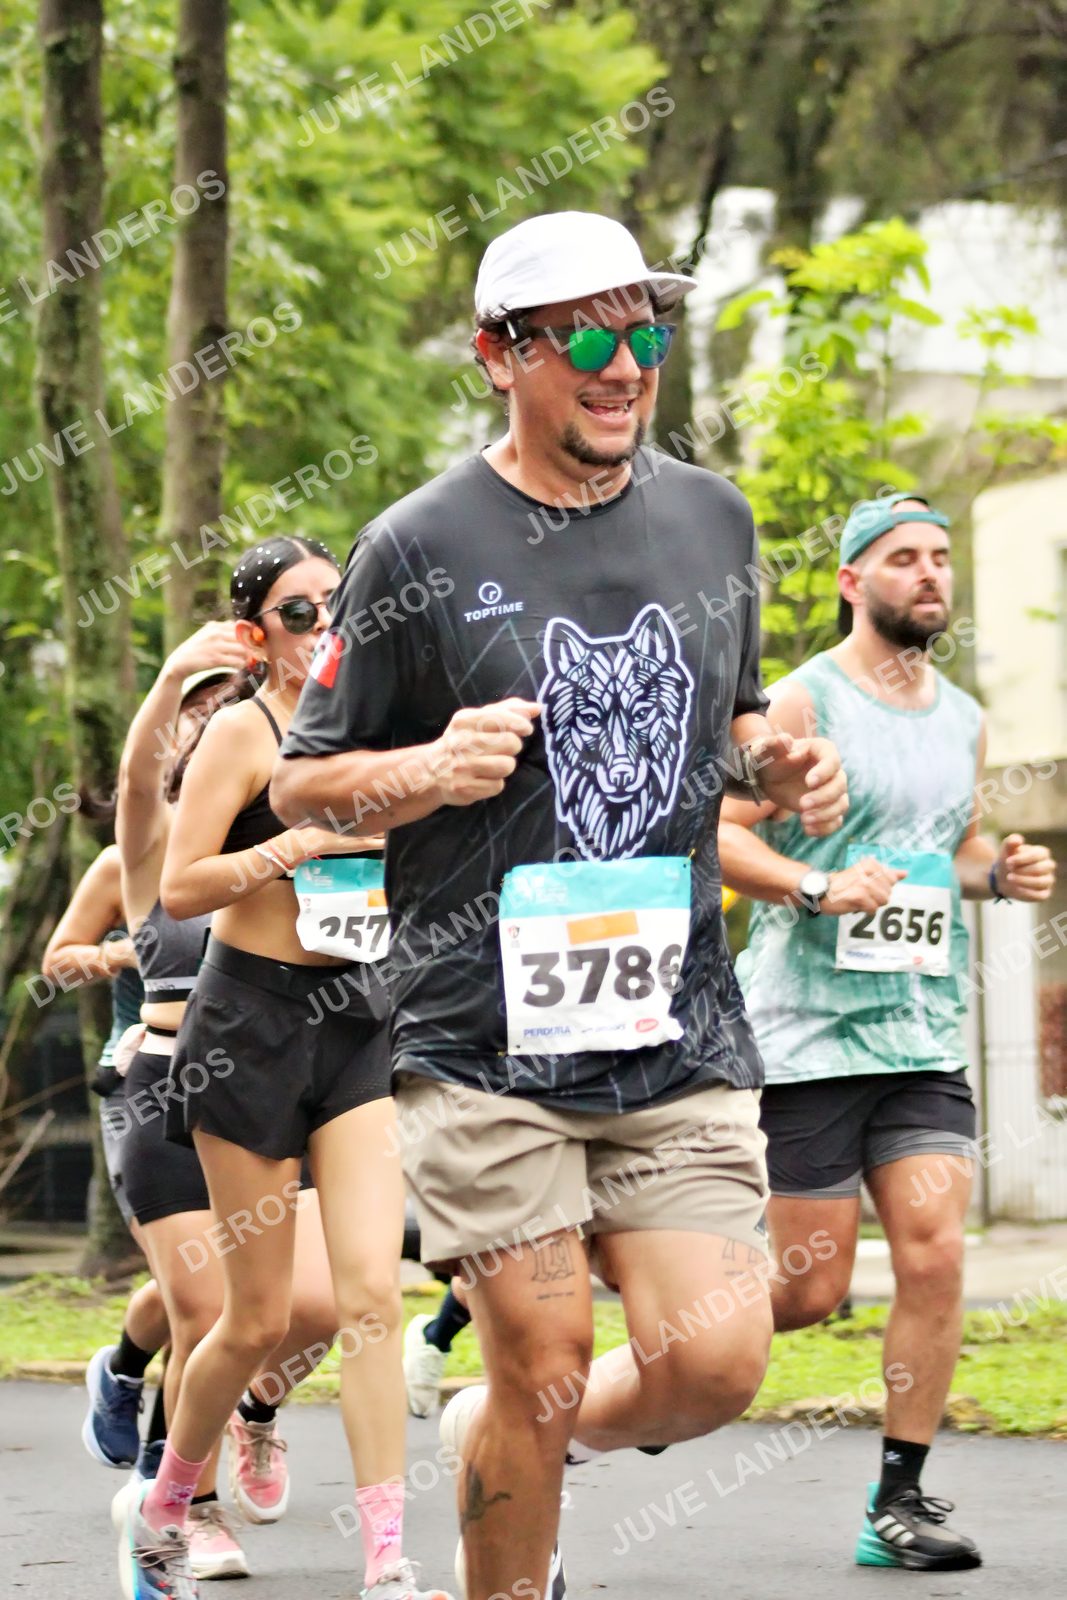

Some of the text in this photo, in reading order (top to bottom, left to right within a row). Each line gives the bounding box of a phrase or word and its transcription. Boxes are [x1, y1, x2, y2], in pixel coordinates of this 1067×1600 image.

[464, 601, 524, 623] TOPTIME
[849, 906, 945, 946] 2656
[521, 943, 683, 1008] 3786
